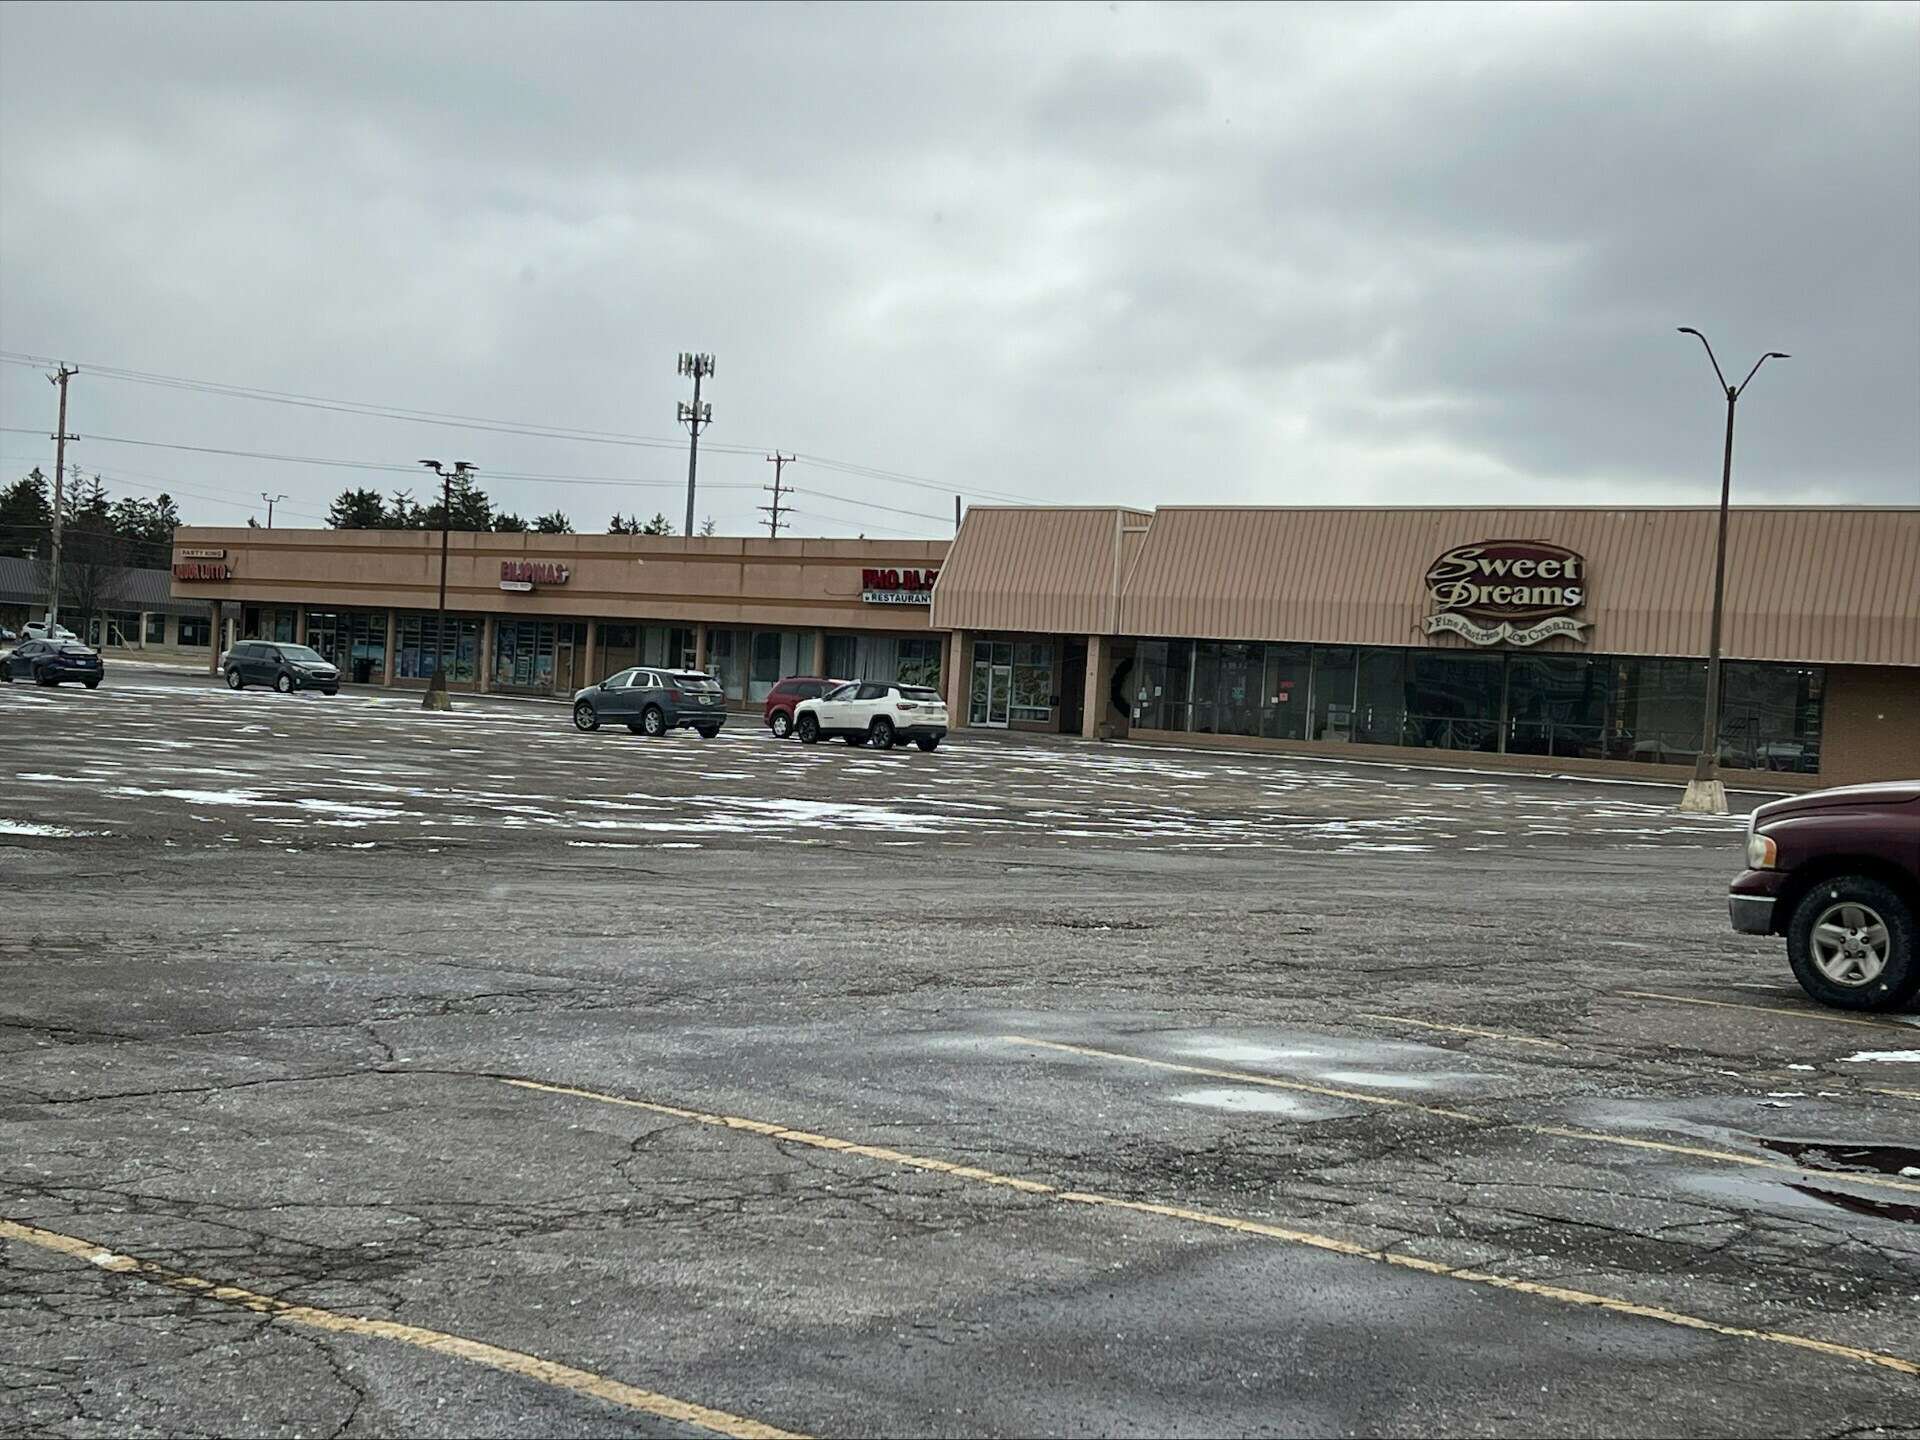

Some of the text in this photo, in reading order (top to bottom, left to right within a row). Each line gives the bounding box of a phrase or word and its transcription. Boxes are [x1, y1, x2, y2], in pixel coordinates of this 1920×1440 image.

[201, 564, 226, 580] LOTTO
[1427, 549, 1578, 579] Sweet
[1431, 577, 1582, 609] Dreams
[1434, 617, 1576, 643] Fine Pastries Ice Cream
